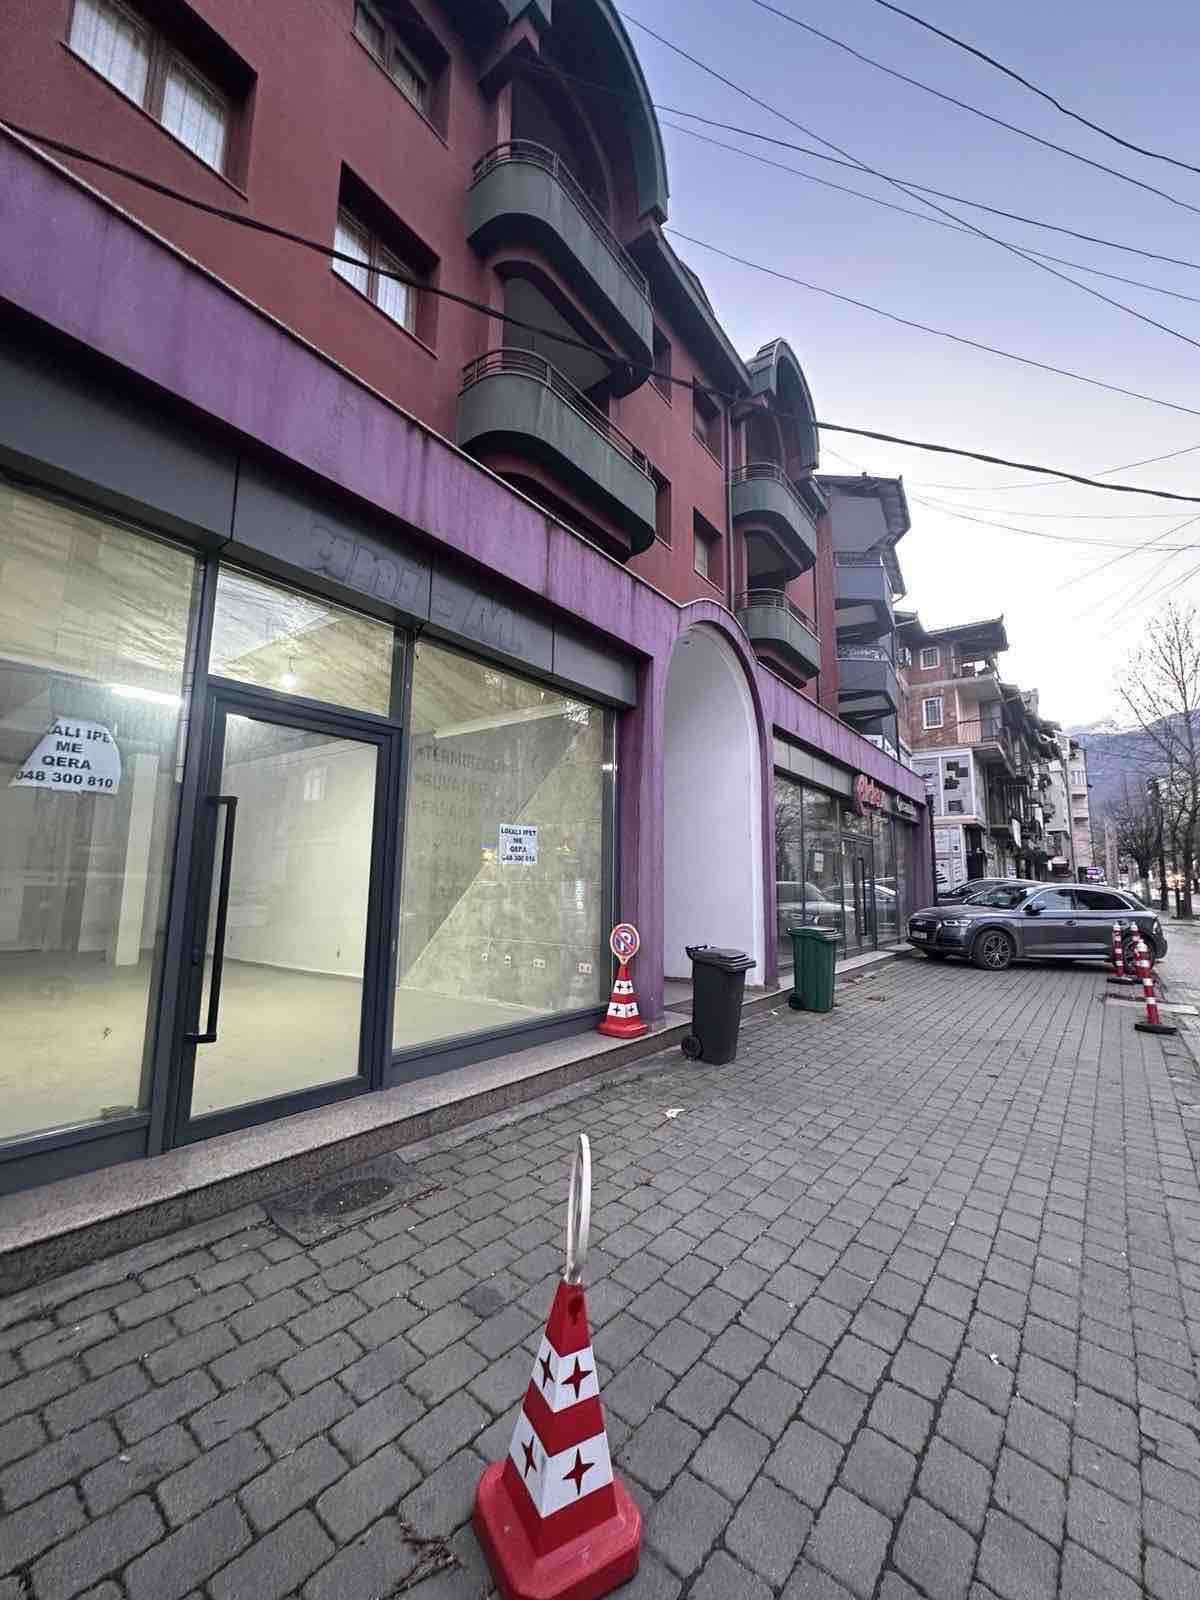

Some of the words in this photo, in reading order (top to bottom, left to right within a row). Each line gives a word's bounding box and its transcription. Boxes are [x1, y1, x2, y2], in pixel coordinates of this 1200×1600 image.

[49, 725, 80, 738] ALI
[56, 741, 83, 753] ME
[42, 755, 91, 770] QERA
[52, 772, 83, 785] 300
[87, 776, 113, 788] 810
